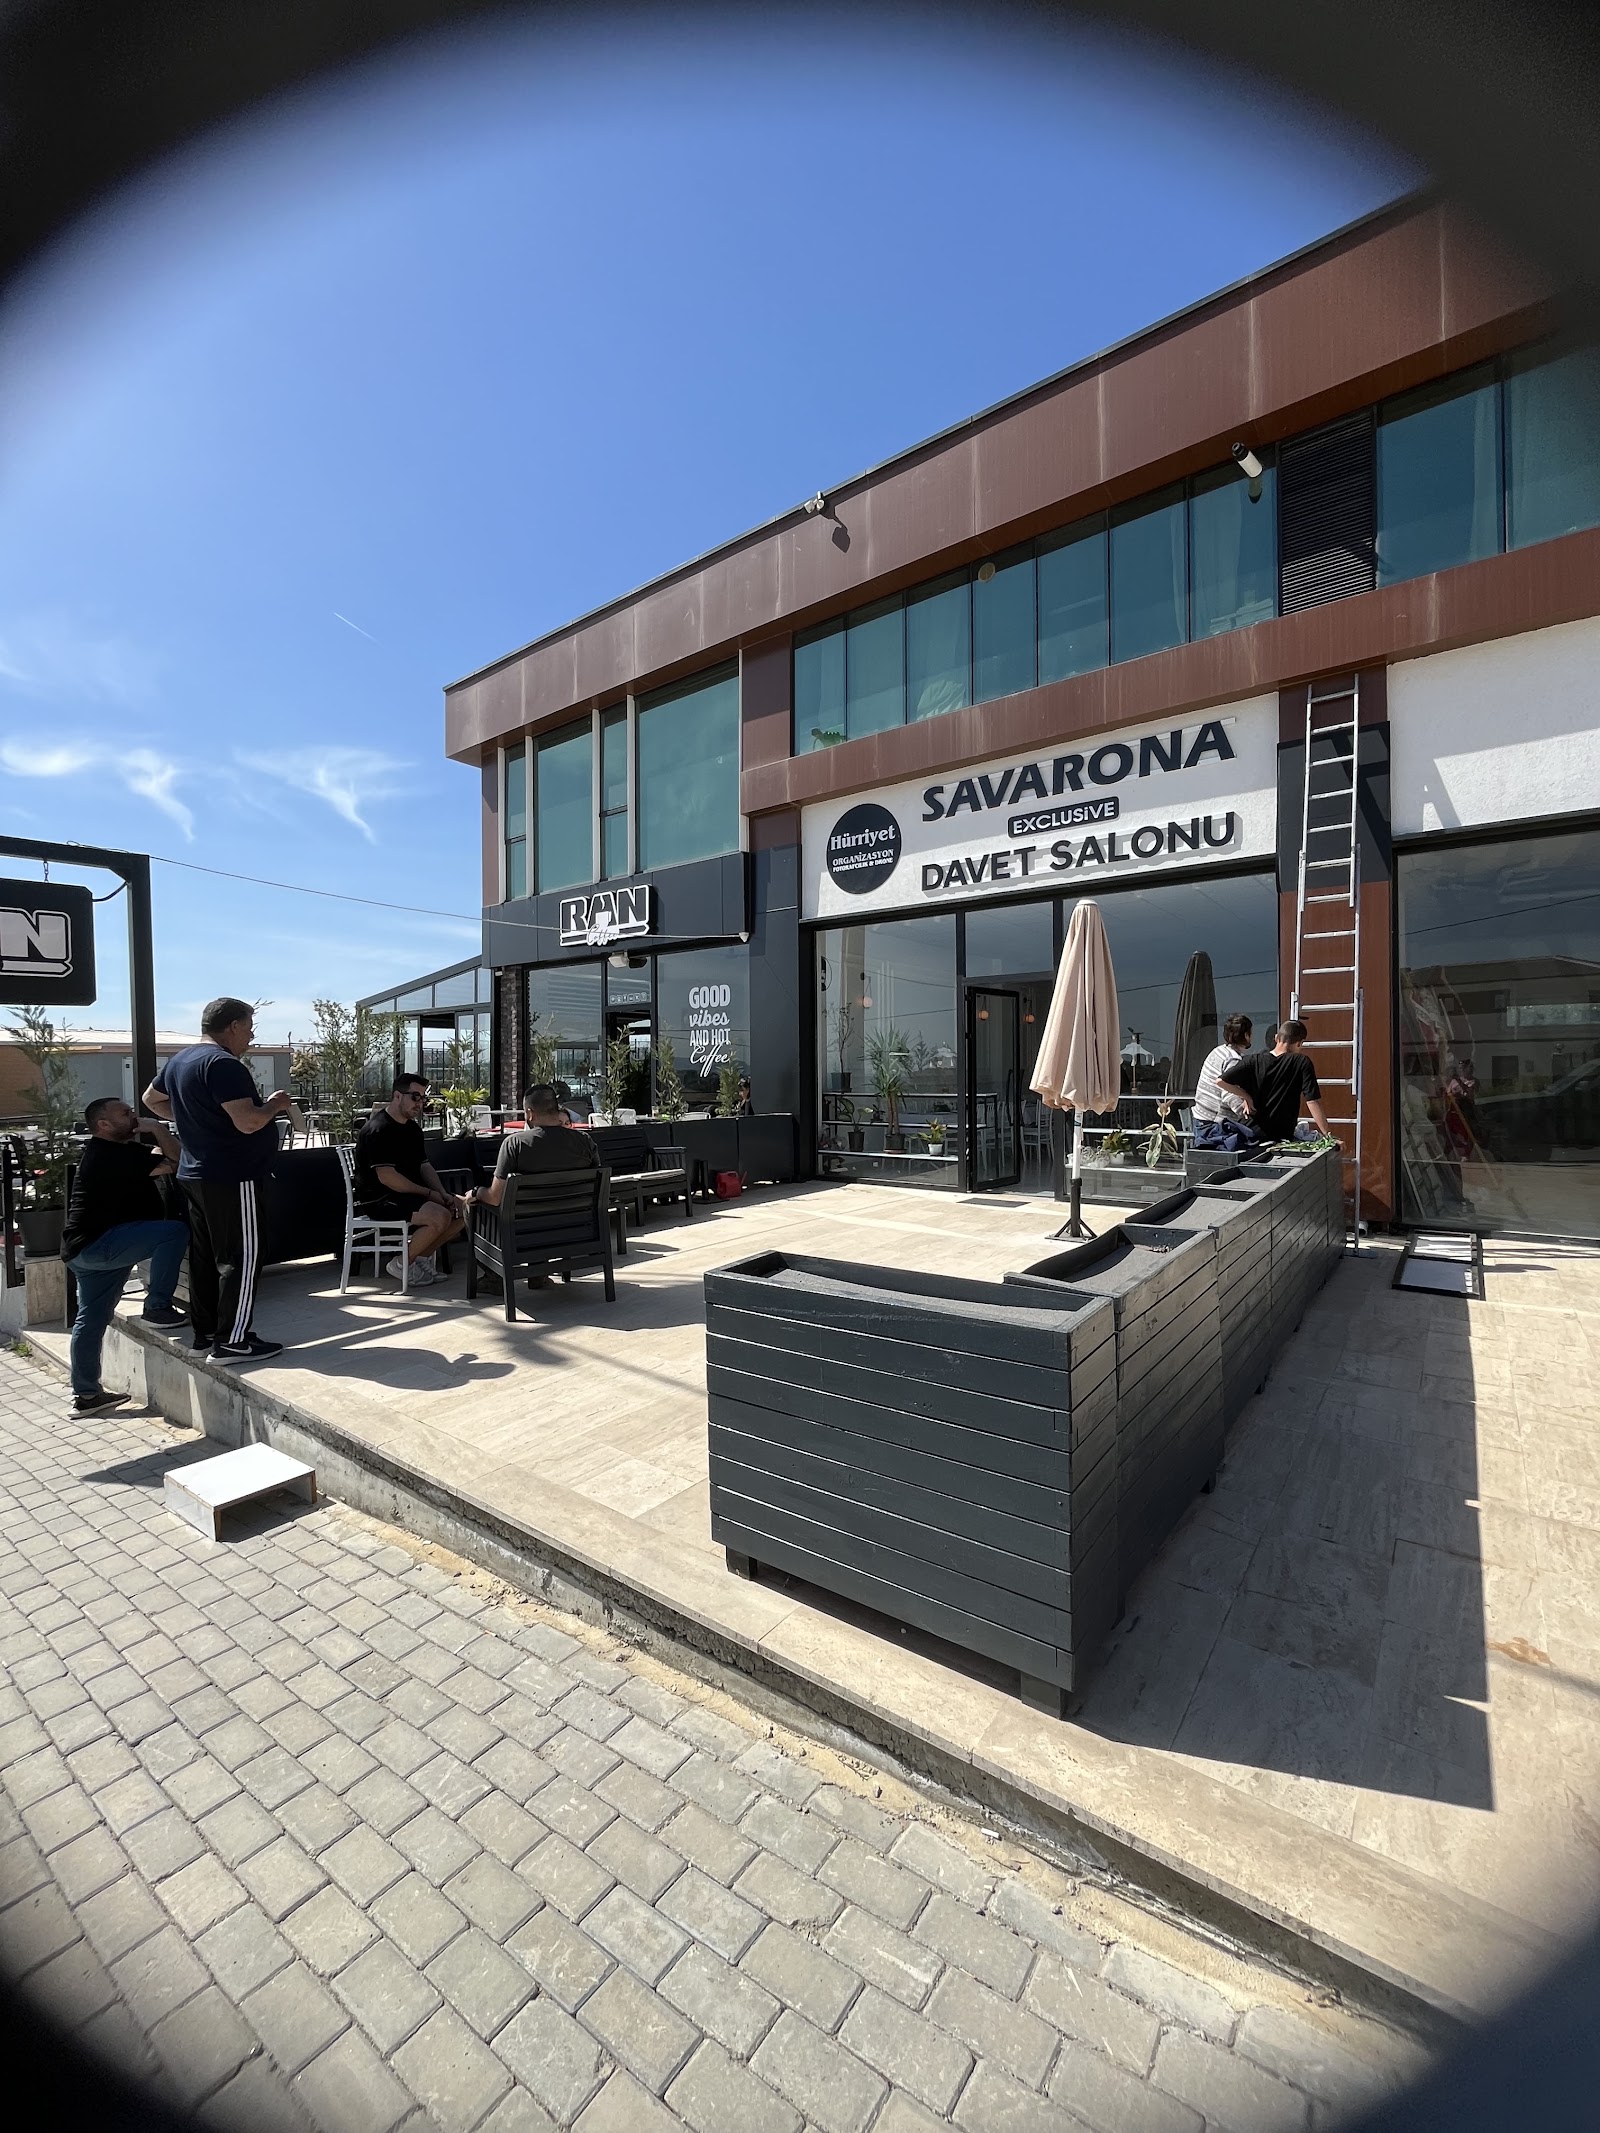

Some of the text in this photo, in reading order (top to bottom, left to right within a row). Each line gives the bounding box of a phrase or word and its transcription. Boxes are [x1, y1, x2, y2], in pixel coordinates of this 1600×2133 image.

[921, 720, 1235, 822] SAVARONA
[830, 825, 896, 850] Hürriyet
[921, 811, 1235, 892] DAVET SALONU
[560, 884, 650, 933] RAN
[689, 984, 731, 1009] GOOD
[689, 1009, 731, 1028] vibes
[689, 1028, 731, 1047] AND HOT
[690, 1039, 731, 1078] Coffee
